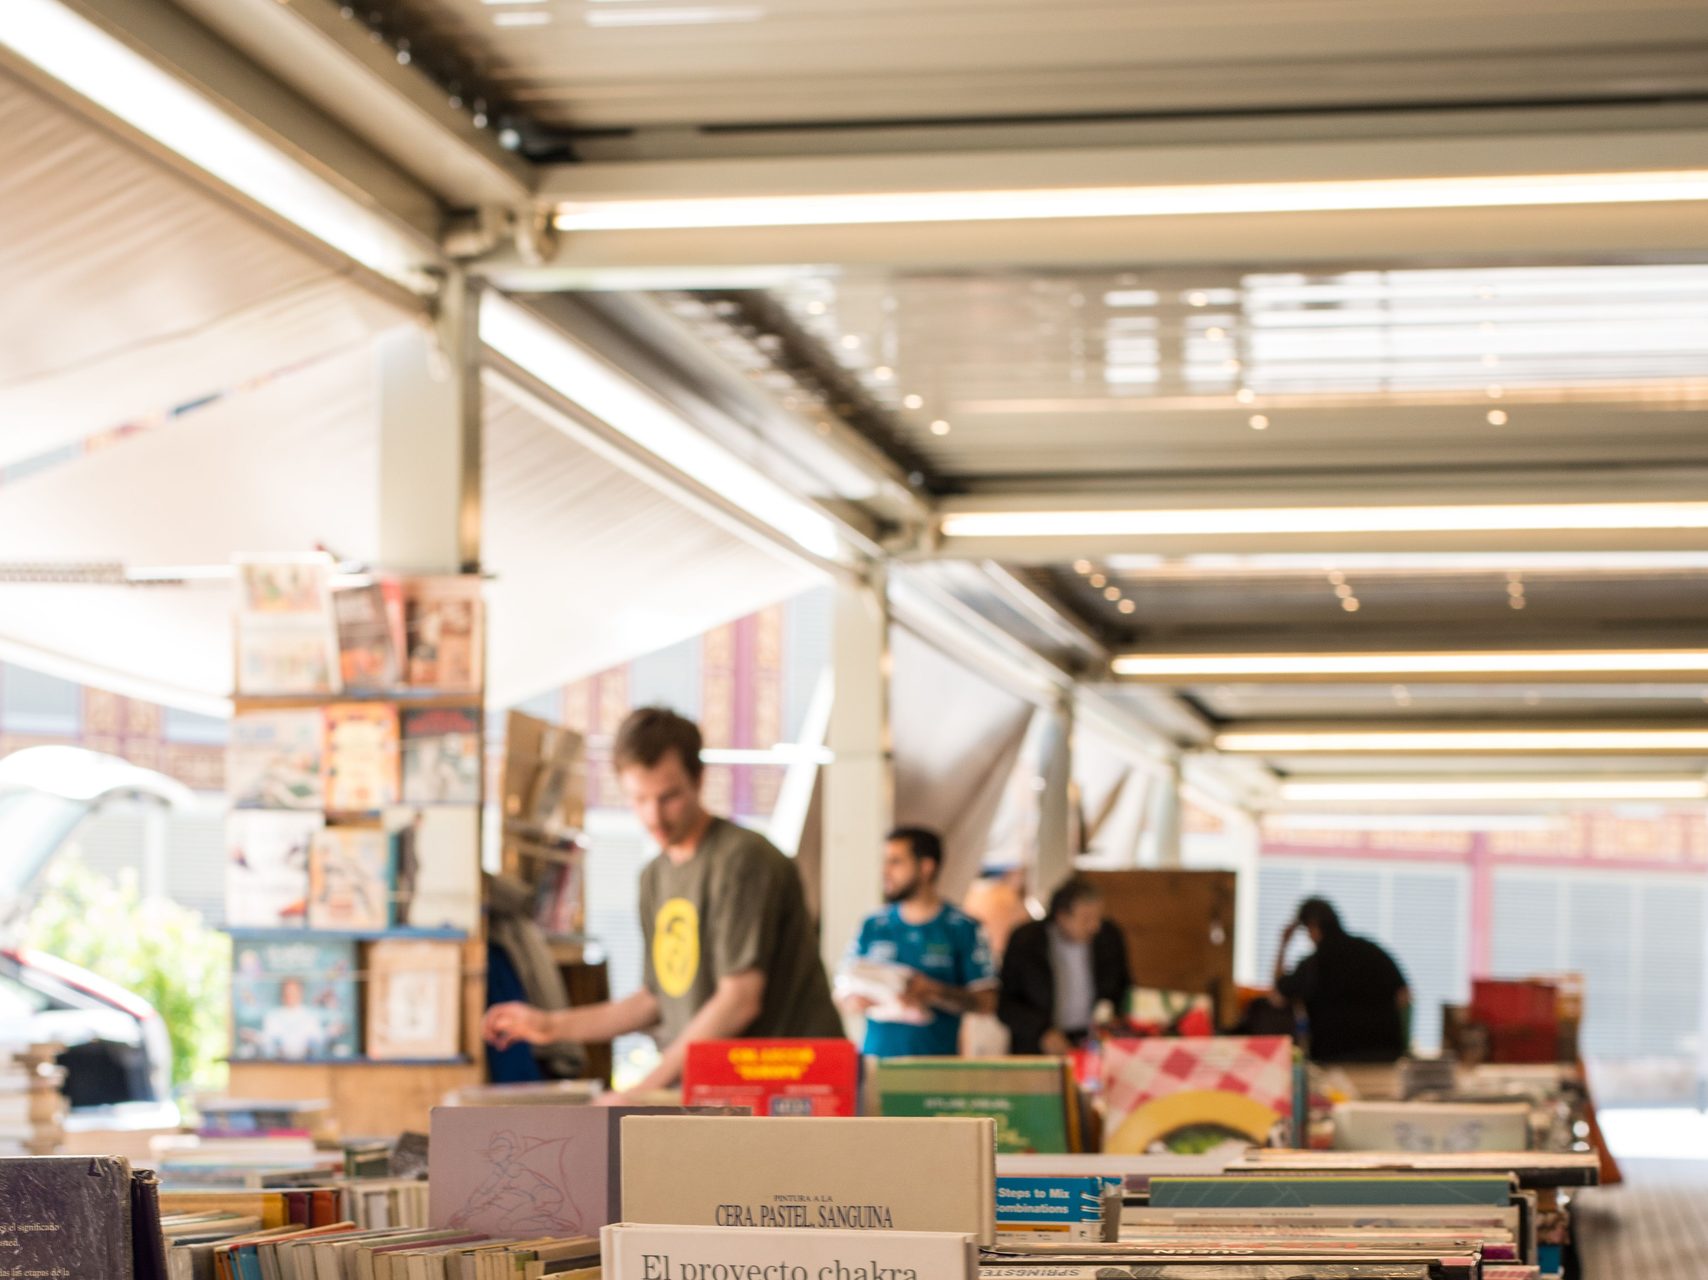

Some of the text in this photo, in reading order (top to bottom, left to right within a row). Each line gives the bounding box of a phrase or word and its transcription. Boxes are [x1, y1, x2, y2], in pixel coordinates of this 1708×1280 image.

[998, 1188, 1070, 1199] Steps to Mix
[818, 1205, 893, 1228] SANGUINA
[642, 1254, 671, 1280] El
[979, 1269, 1080, 1277] SPRINGSTE
